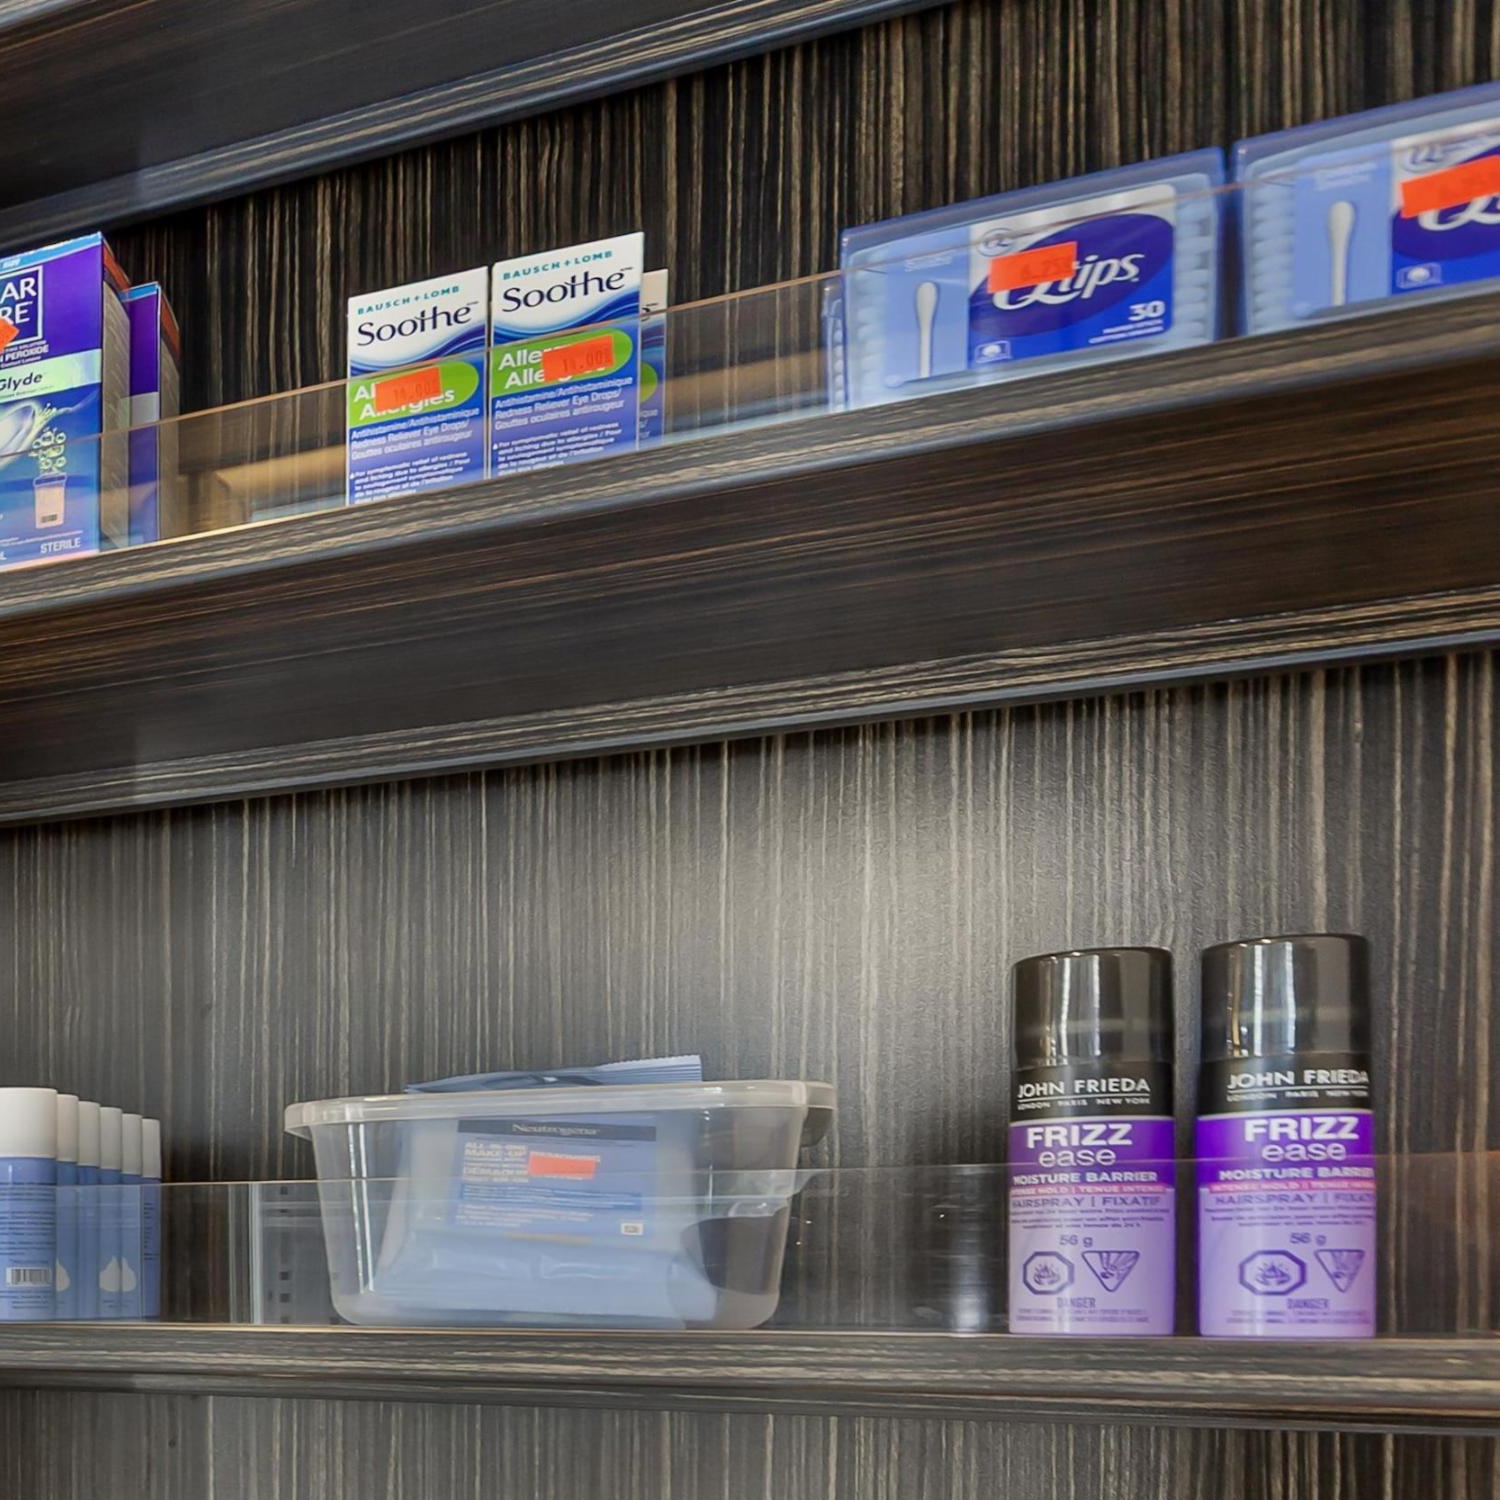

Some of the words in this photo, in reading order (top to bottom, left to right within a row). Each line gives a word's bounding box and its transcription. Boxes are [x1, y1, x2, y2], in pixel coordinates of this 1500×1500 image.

[503, 260, 561, 281] BAUSCH
[574, 249, 613, 264] LOMB
[357, 297, 411, 316] BAUSCH
[424, 285, 461, 300] LOMB
[502, 269, 626, 313] Soothe
[1128, 300, 1165, 321] 30
[357, 304, 473, 347] Soothe
[40, 537, 82, 555] STERILE
[1017, 1081, 1065, 1098] JOHN
[1074, 1077, 1151, 1094] FRIEDA
[1226, 1071, 1295, 1089] JOHN
[1303, 1069, 1369, 1084] FRIEDA
[511, 1122, 599, 1137] Neutrogena
[1026, 1123, 1133, 1149] FRIZZ
[1244, 1116, 1360, 1142] FRIZZ
[1038, 1148, 1116, 1168] ease
[1261, 1142, 1347, 1162] ease
[1012, 1172, 1081, 1186] MOISTURE
[1086, 1171, 1158, 1183] BARRIER
[1218, 1168, 1314, 1181] MOISTURE
[1059, 1234, 1078, 1246] 56
[1083, 1236, 1094, 1248] g
[1289, 1232, 1311, 1244] 56
